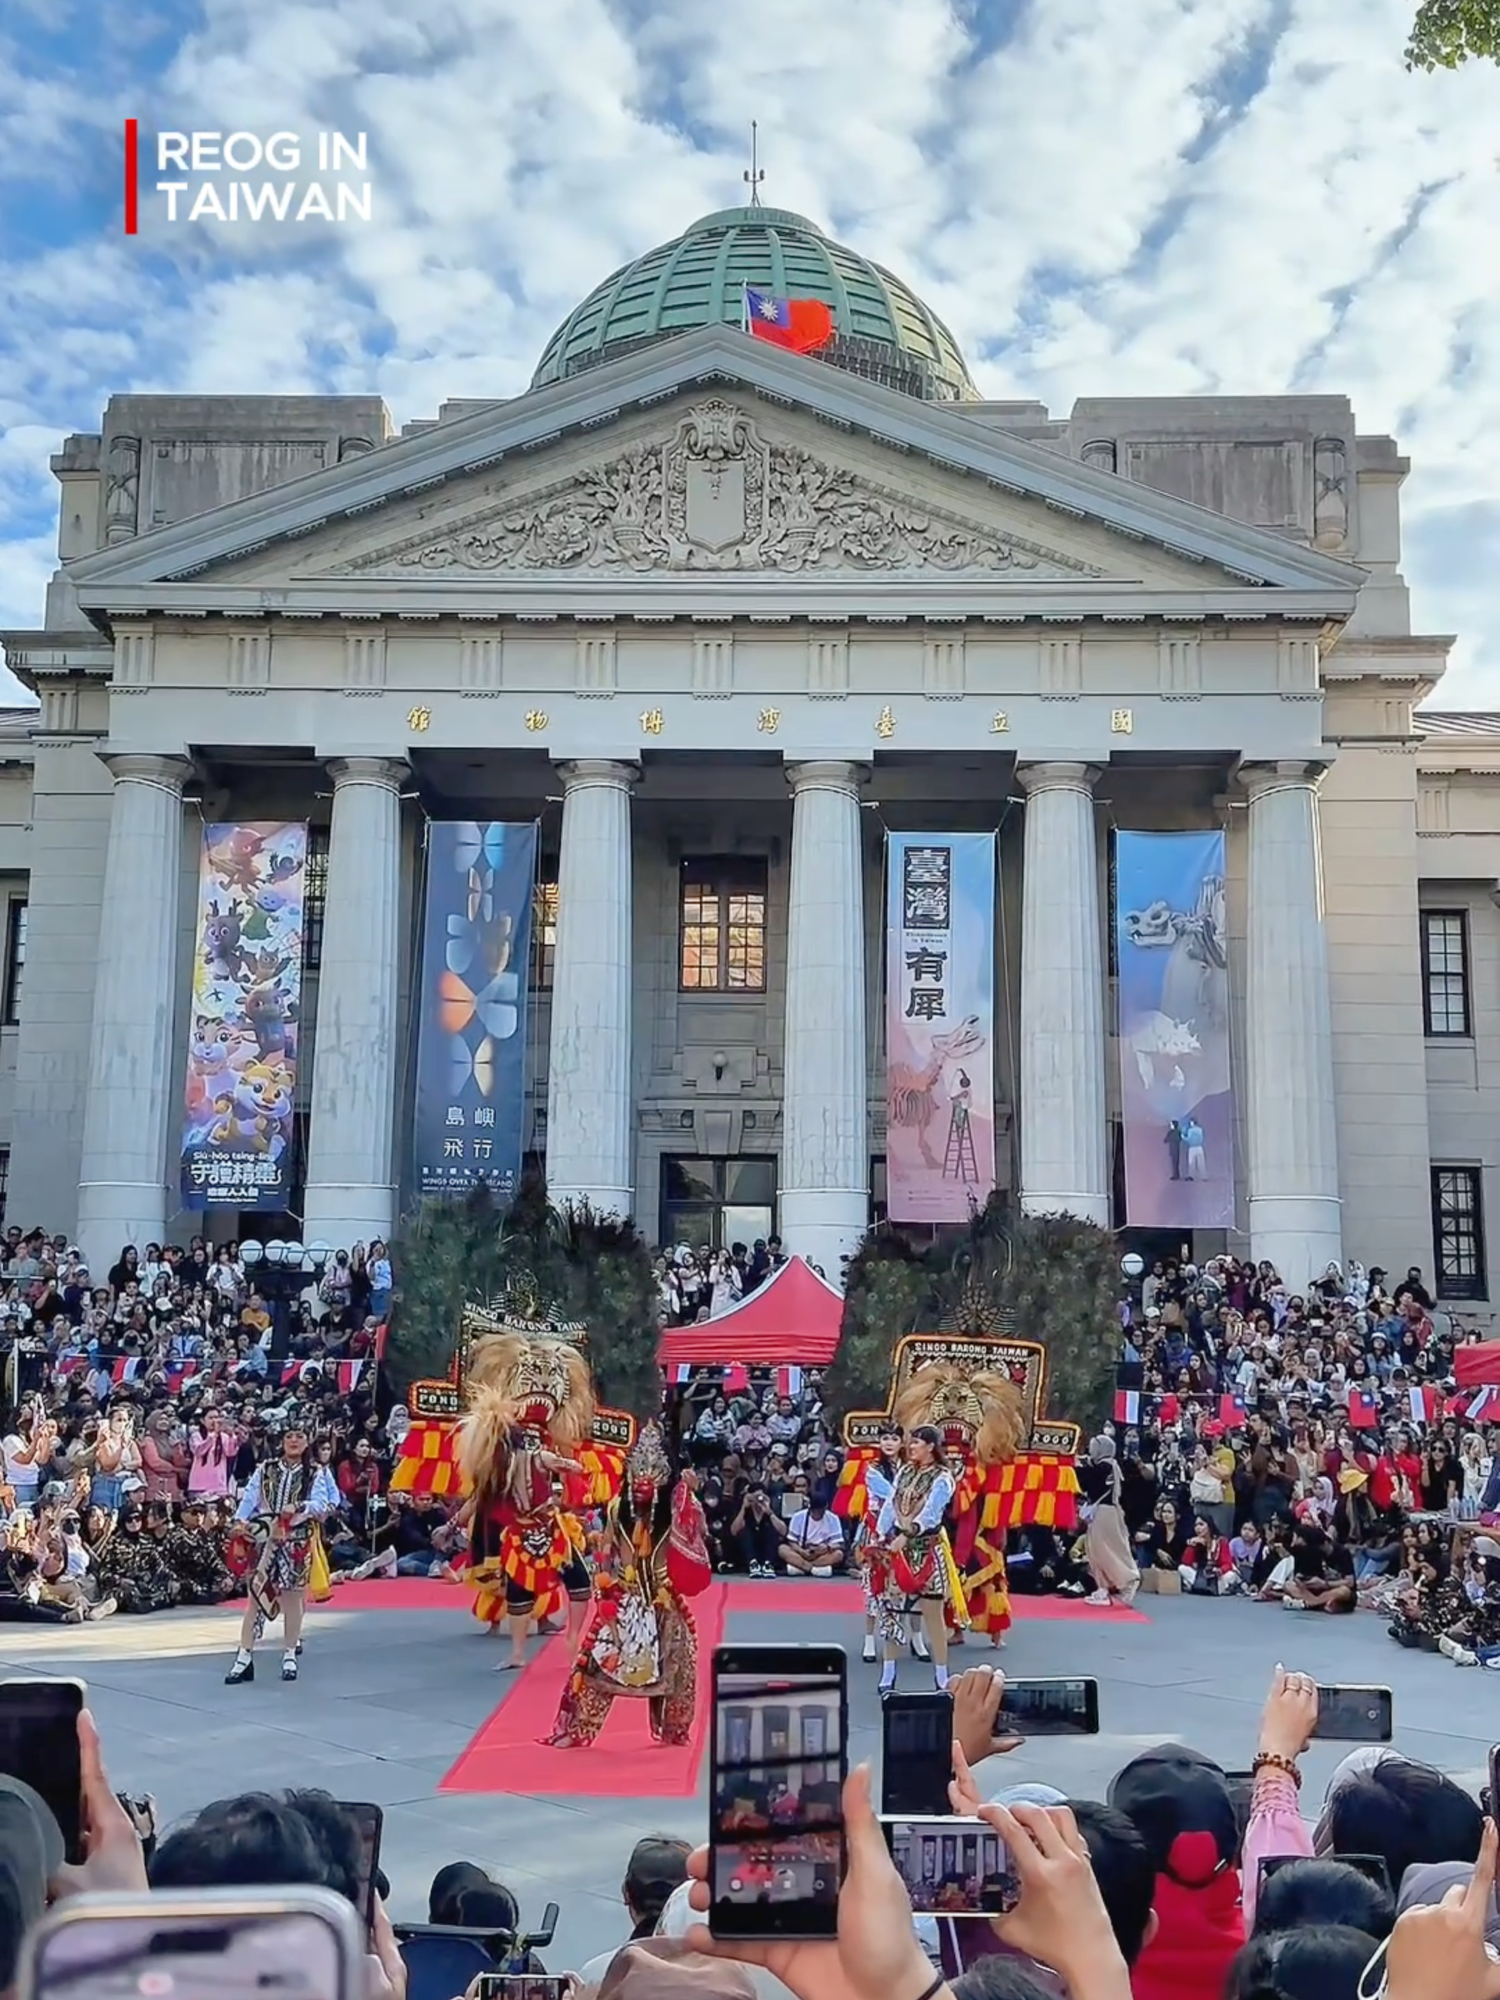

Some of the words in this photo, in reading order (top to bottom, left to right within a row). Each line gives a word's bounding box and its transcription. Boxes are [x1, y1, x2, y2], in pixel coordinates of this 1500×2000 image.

[906, 849, 949, 921] 臺灣
[445, 1106, 496, 1128] 島嶼
[443, 1137, 493, 1159] 飛行
[503, 1314, 552, 1332] BARONG
[914, 1342, 948, 1352] SINGO
[992, 1346, 1030, 1357] TAIWAN
[852, 1425, 880, 1436] PON
